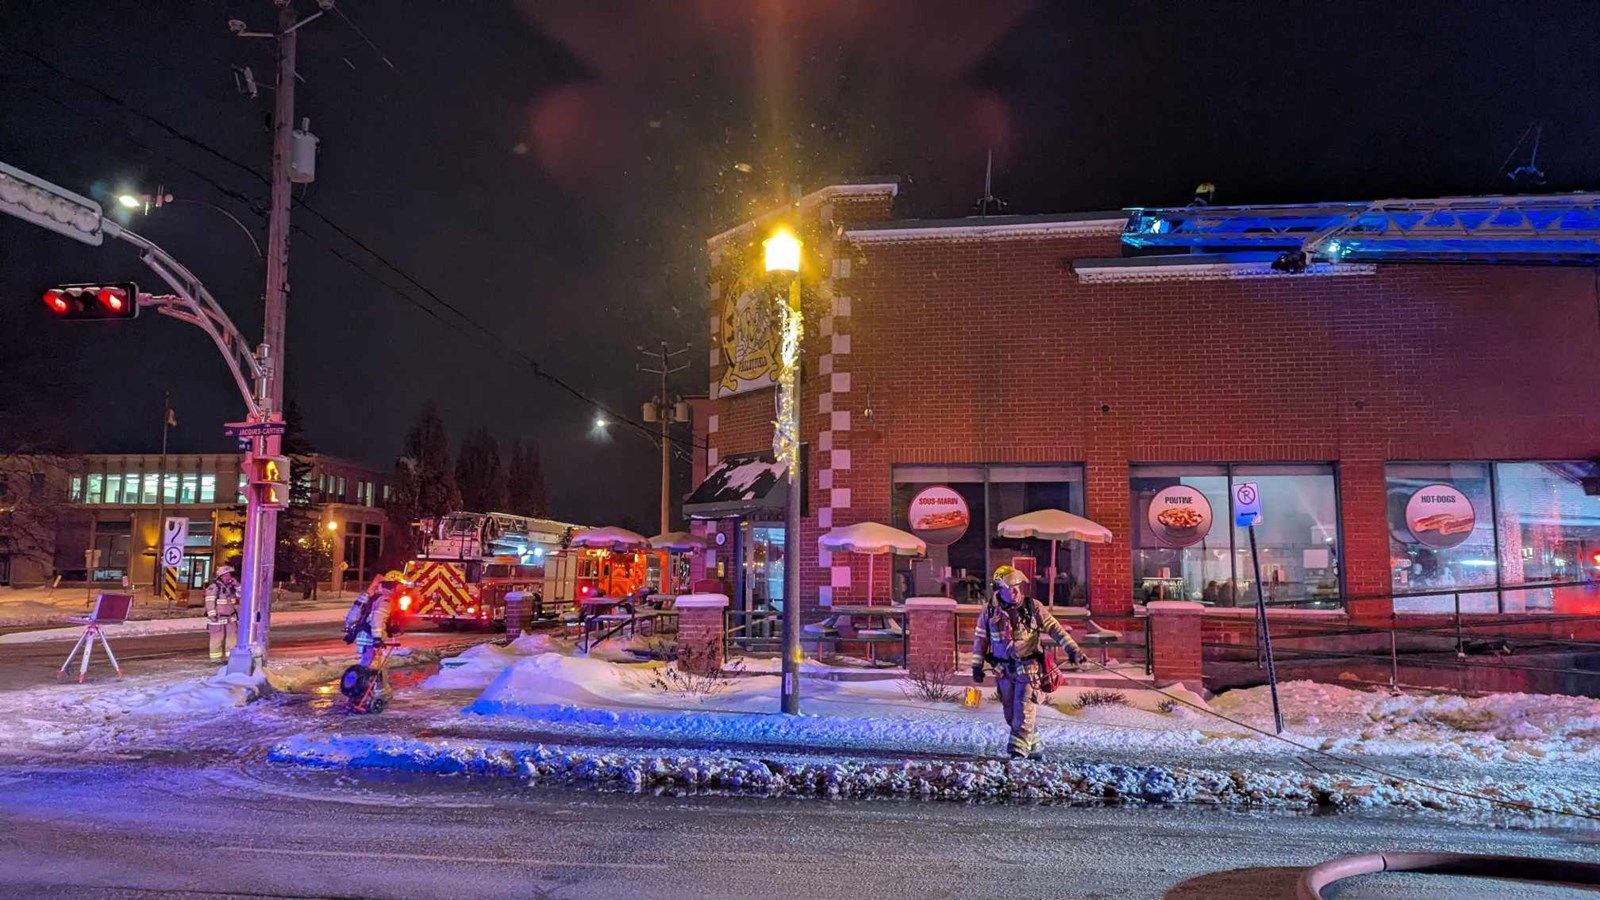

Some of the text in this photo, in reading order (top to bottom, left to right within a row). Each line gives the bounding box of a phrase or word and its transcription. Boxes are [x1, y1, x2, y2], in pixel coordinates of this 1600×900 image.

[918, 497, 958, 505] SOUS-MARIN
[1164, 496, 1193, 504] POUTINE
[1421, 495, 1456, 503] HOT-DOGS
